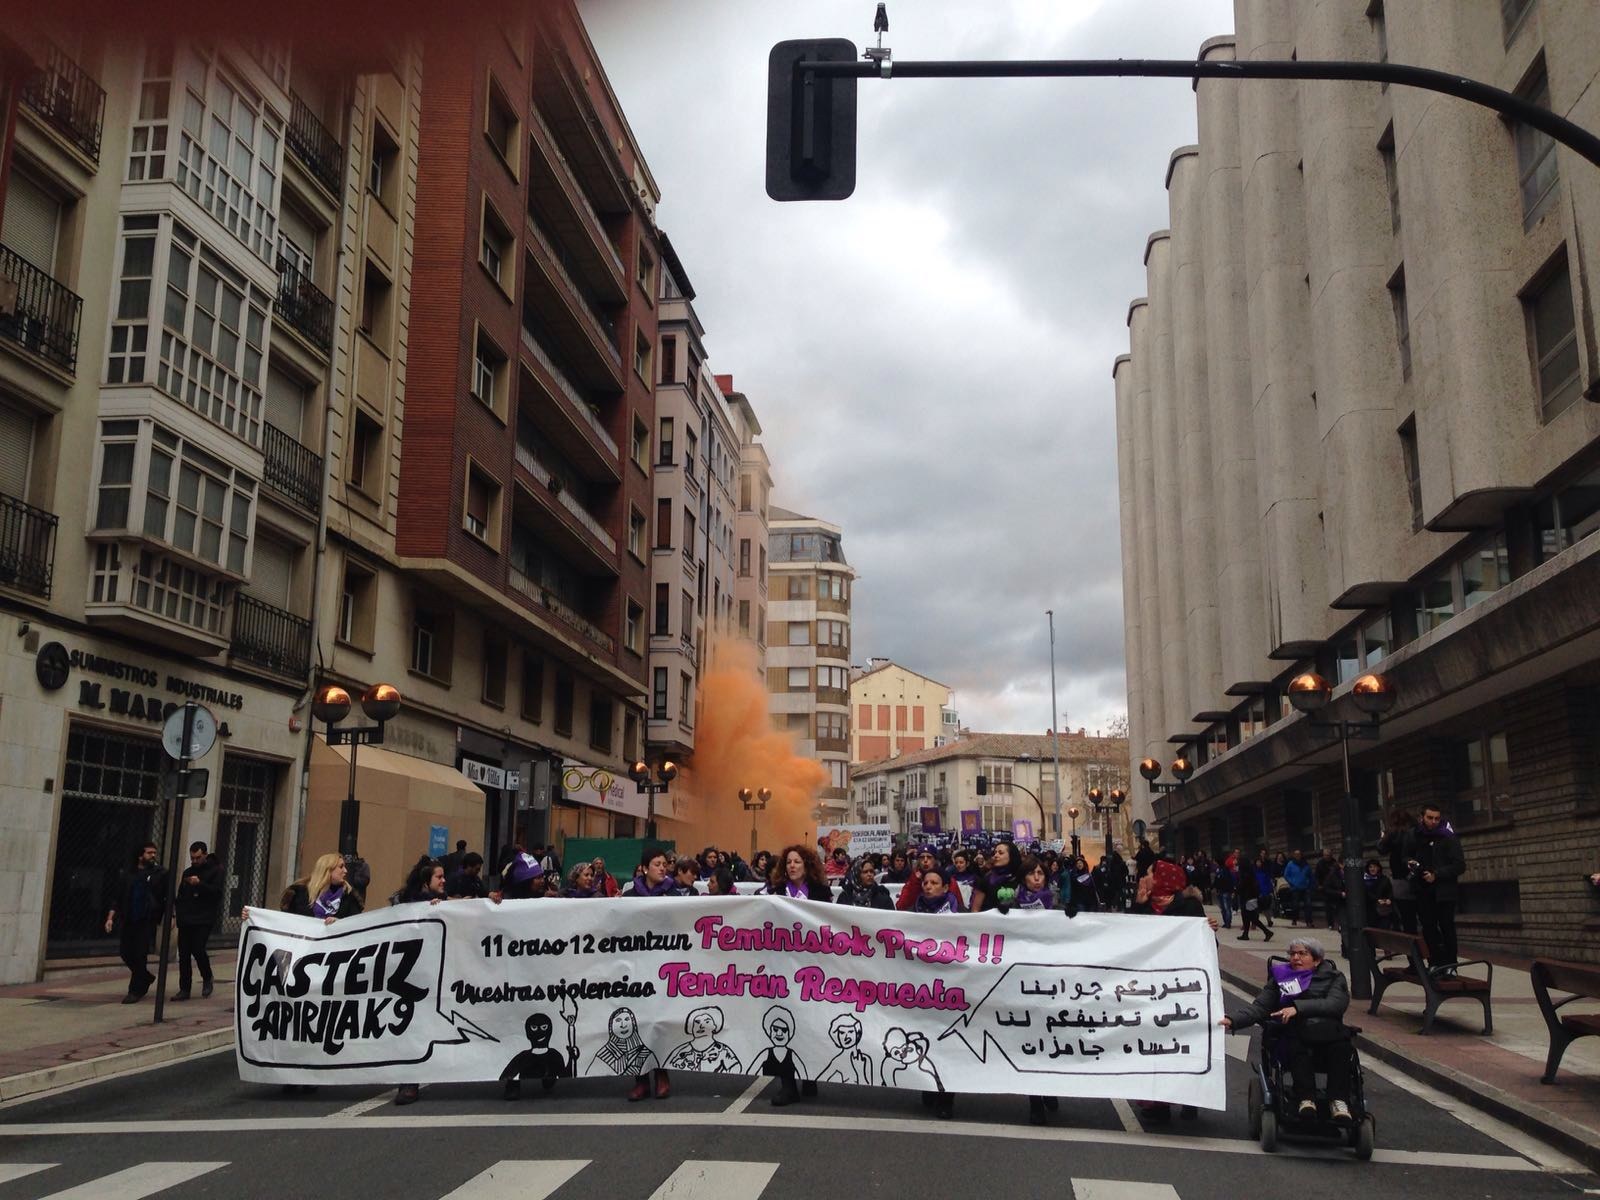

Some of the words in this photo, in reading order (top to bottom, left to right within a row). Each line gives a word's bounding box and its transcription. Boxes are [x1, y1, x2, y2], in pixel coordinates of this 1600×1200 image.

[69, 648, 158, 688] SUMINISTROS
[166, 674, 243, 710] INDUSTRIALES
[481, 934, 503, 957] 11
[507, 937, 568, 957] eraso
[570, 933, 595, 954] 12
[598, 930, 693, 953] erantzun
[695, 915, 876, 958] Feministok
[876, 928, 970, 965] Prest
[243, 938, 429, 1017] GASTEIZ
[547, 975, 656, 1000] violencias
[658, 962, 789, 999] Tendrán
[794, 966, 971, 1013] Respuesta
[1020, 979, 1103, 1000] جوابنا
[1114, 977, 1203, 1003] سنريكم
[252, 998, 392, 1055] APIRILAK
[388, 998, 414, 1036] 9
[995, 1010, 1032, 1027] لنا
[1045, 1009, 1142, 1033] تعنيفكم
[1153, 1003, 1200, 1028] على
[1021, 1036, 1105, 1060] جاهزات
